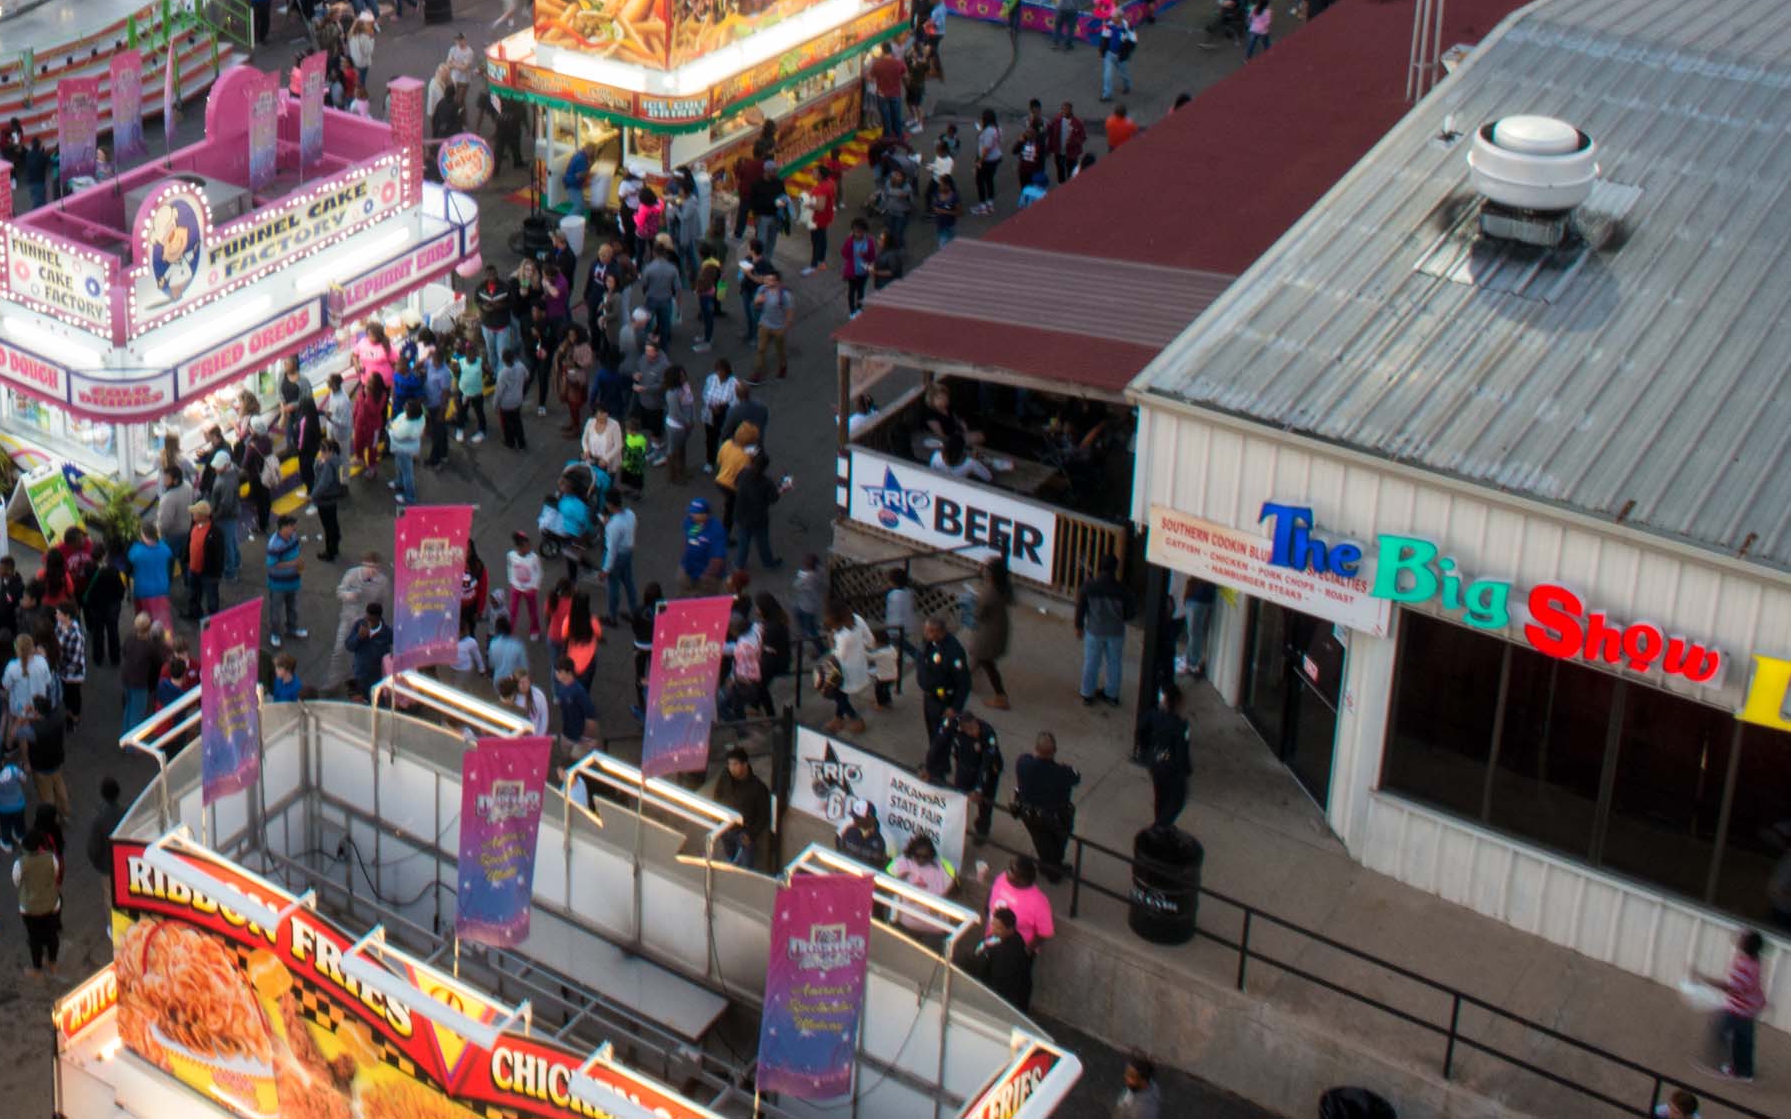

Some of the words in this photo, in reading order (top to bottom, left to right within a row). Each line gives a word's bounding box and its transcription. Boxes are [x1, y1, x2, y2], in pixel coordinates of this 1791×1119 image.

[210, 213, 301, 265] FUNNEL
[307, 180, 368, 219] CAKE
[11, 239, 62, 267] FUNNEL
[224, 210, 347, 278] FACTORY
[38, 262, 74, 291] CAKE
[344, 258, 413, 307] LEPHANT
[416, 238, 455, 271] EARS
[44, 285, 103, 319] FACTORY
[188, 337, 244, 387] FRIED
[249, 308, 310, 354] OREOS
[9, 352, 59, 390] DOUGH
[866, 487, 930, 513] FRIO
[934, 495, 1044, 567] BEER
[1161, 517, 1209, 543] SOUTHERN
[1211, 532, 1246, 555] COOKIN
[1165, 537, 1202, 555] CATFISH
[1209, 551, 1248, 571] CHICKEN
[1258, 566, 1282, 582] PORK
[1285, 575, 1315, 592] CHOPS
[1324, 588, 1354, 604] ROAST
[1211, 565, 1266, 589] HAMBURGER
[1268, 582, 1302, 601] STEAKS
[1258, 502, 1362, 578] The
[1370, 534, 1512, 629] Big
[1524, 584, 1721, 682] Show
[810, 761, 863, 783] FRIO
[889, 776, 947, 809] ARKANSAS
[889, 795, 917, 817] STATE
[920, 805, 944, 827] FAIR
[888, 813, 940, 845] GROUNDS
[290, 916, 413, 1036] FRIES
